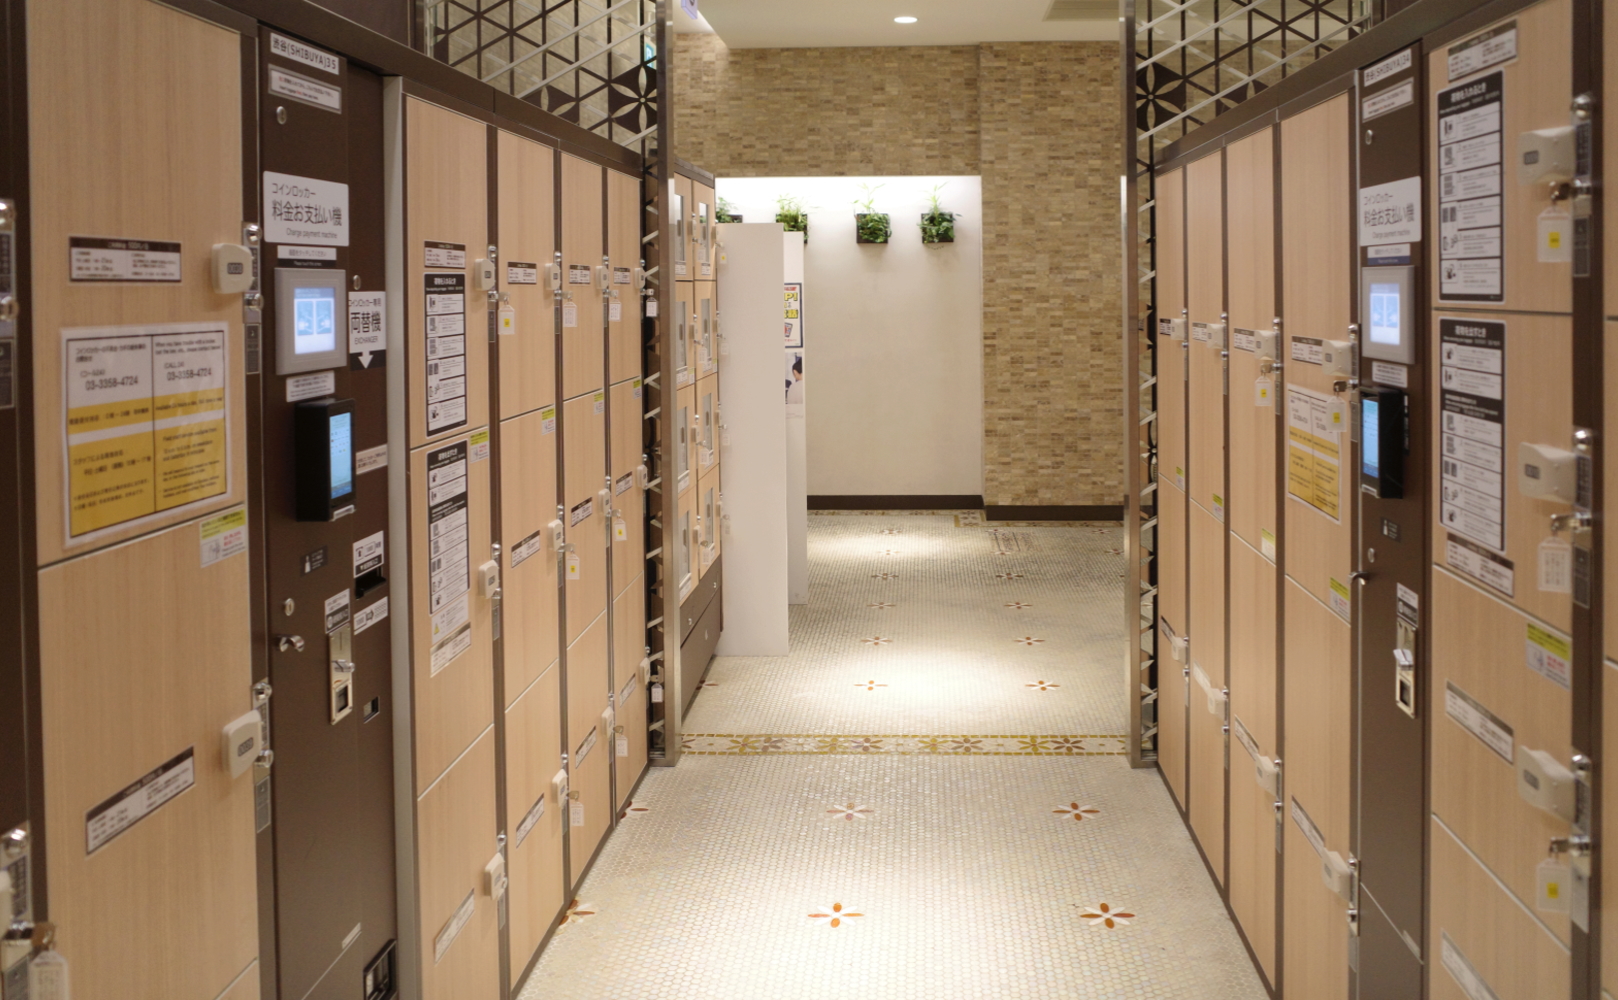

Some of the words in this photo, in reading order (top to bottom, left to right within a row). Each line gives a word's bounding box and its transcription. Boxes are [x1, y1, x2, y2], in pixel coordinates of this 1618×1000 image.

[272, 36, 337, 70] 渋谷(SHIBUYA)35
[271, 182, 316, 199] コインロッカー
[271, 199, 343, 227] 料金お支払い機
[1363, 202, 1415, 228] 料金お支払い機
[350, 311, 382, 334] 両替機
[85, 375, 138, 391] 03-3358-4724
[166, 367, 212, 382] 03-3358-4724
